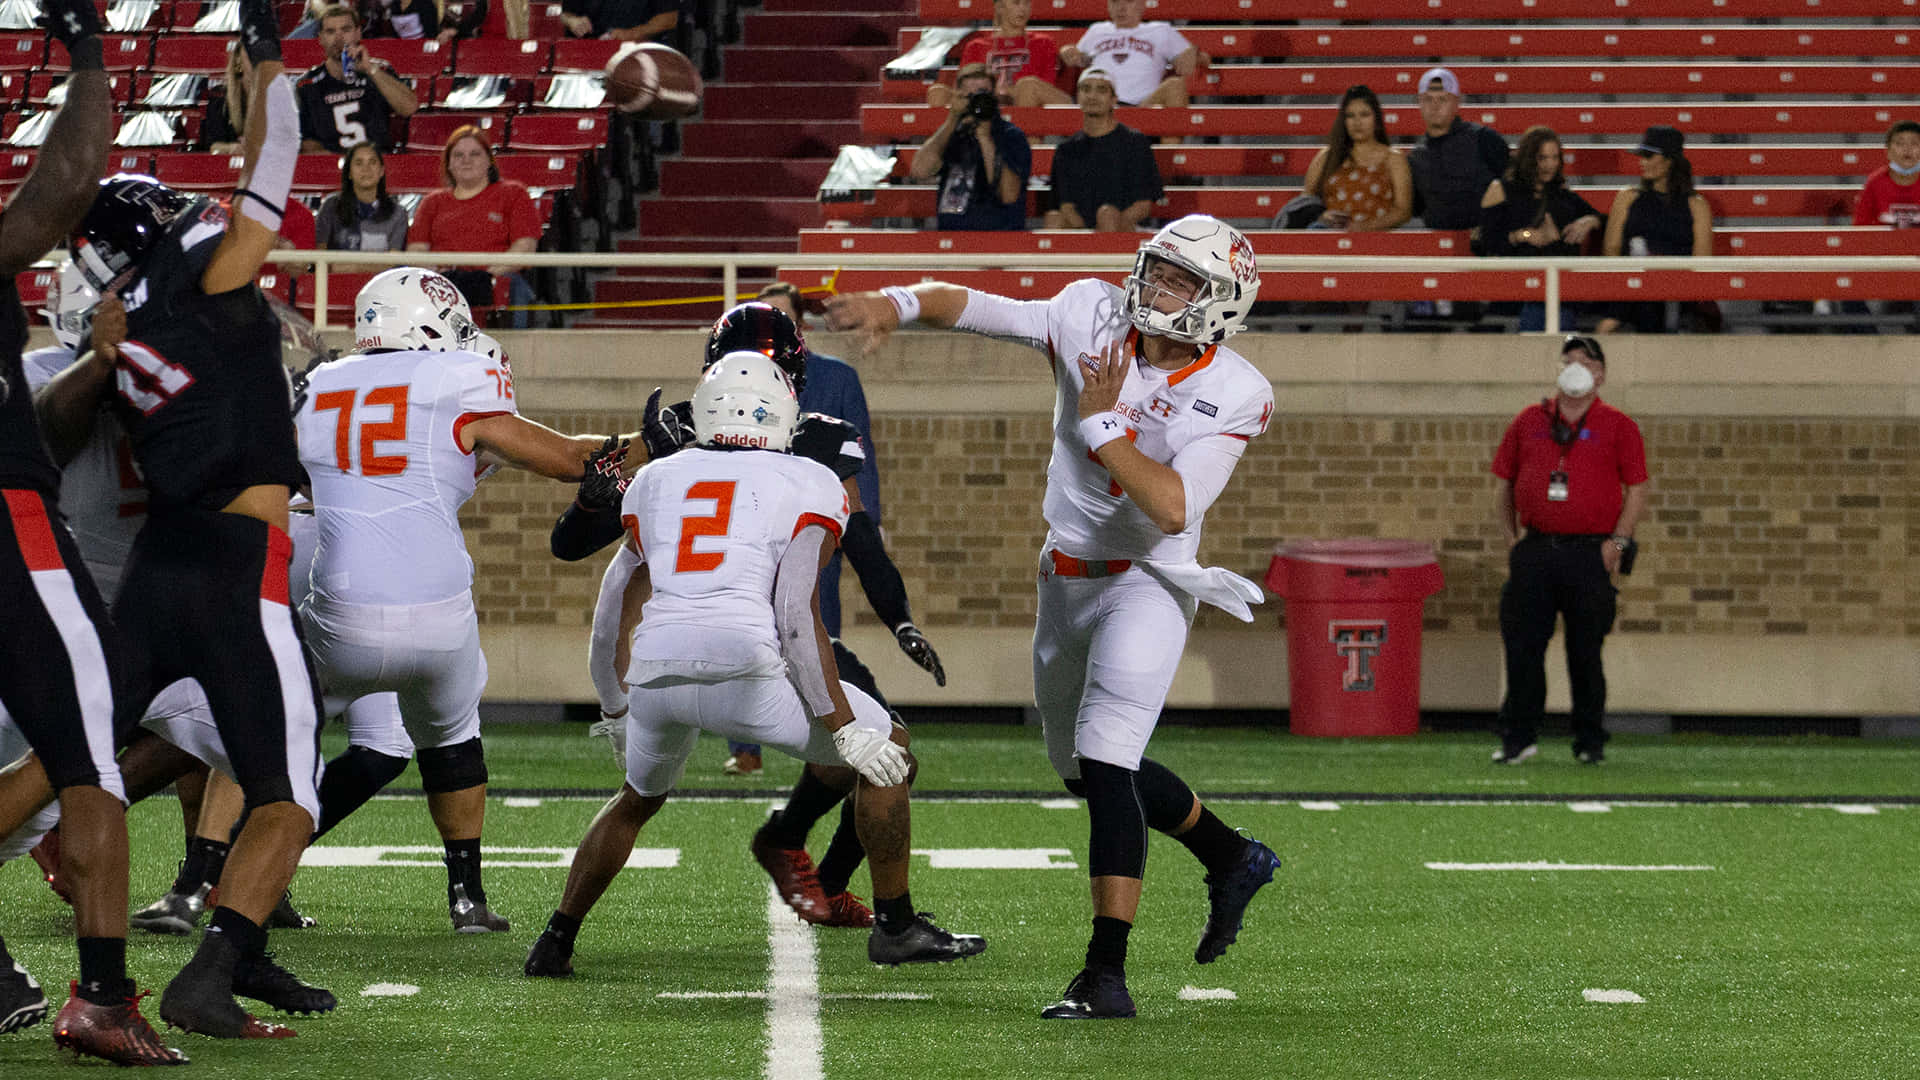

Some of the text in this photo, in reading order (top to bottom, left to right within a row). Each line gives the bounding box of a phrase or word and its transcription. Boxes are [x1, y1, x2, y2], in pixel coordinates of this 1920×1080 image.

[333, 101, 368, 148] 5
[313, 383, 411, 477] 72
[1112, 401, 1144, 424] USKIES
[714, 433, 768, 448] Riddell
[672, 480, 740, 576] 2
